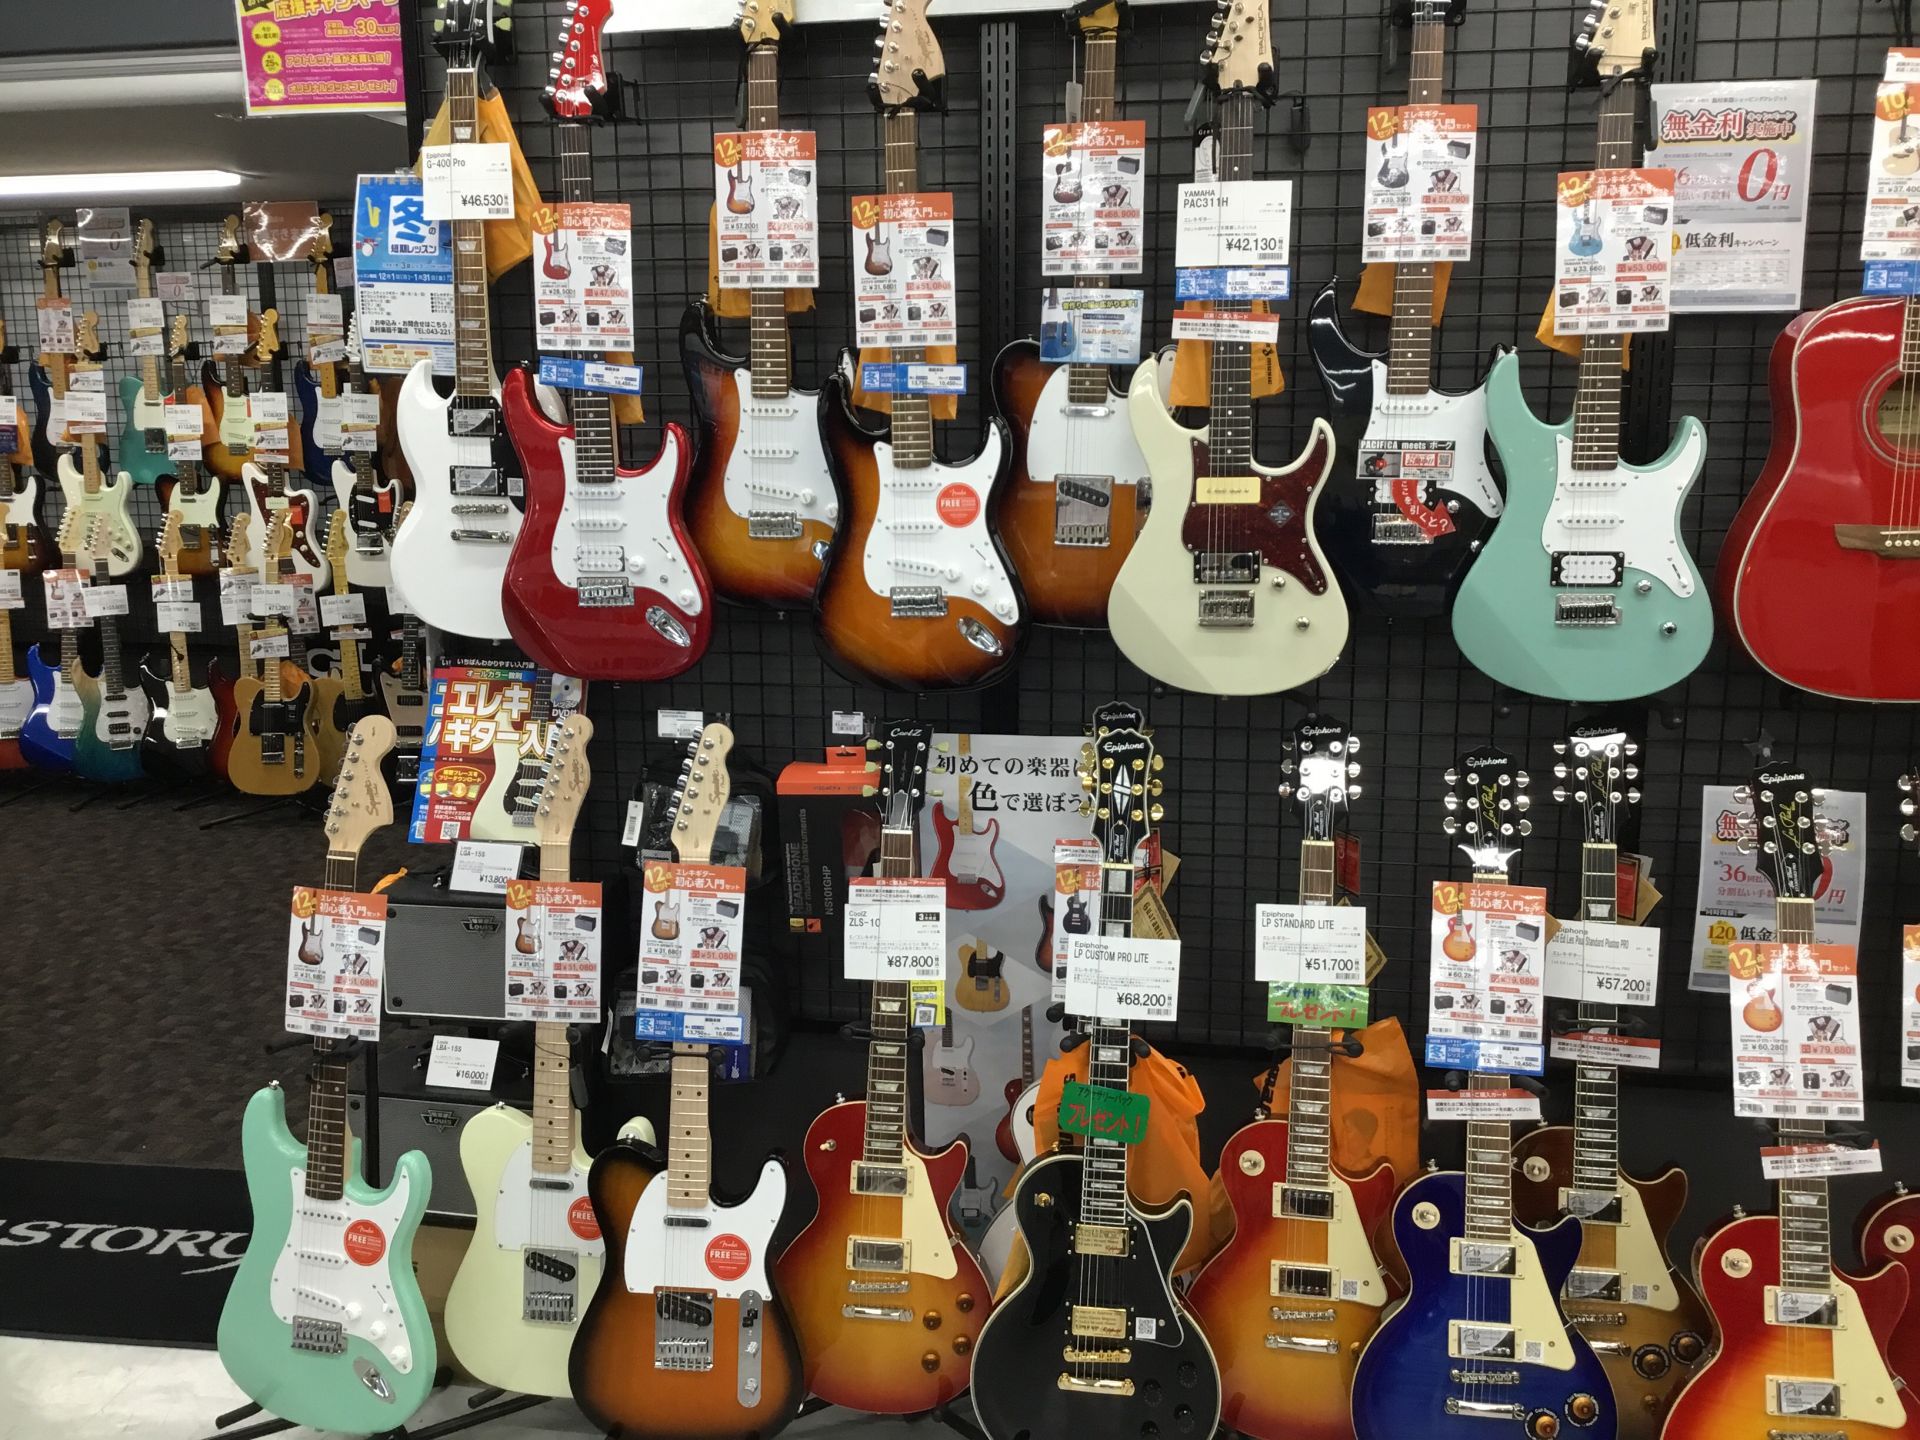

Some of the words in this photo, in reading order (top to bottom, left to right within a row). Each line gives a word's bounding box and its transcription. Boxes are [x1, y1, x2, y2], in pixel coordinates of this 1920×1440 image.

[1404, 110, 1446, 119] エレキギター
[1664, 110, 1744, 139] 無金利
[1747, 121, 1793, 137] 実施中
[426, 158, 451, 169] G-400
[452, 158, 465, 168] Pro
[1184, 189, 1215, 197] YAMAHA
[461, 194, 503, 207] ¥46,530
[1183, 197, 1229, 208] PAC311H
[391, 243, 437, 254] 短期レッスン
[1226, 237, 1277, 251] ¥42,130
[1360, 440, 1398, 449] PACIFICA
[1401, 440, 1426, 449] meets
[1429, 441, 1452, 449] ホーク
[940, 499, 960, 508] FREE
[448, 681, 531, 720] エレキ
[552, 700, 577, 708] レッスン
[1100, 711, 1136, 721] Epiphone
[891, 728, 923, 738] CoolZ
[1302, 725, 1341, 737] Epiphone
[1575, 727, 1617, 738] Epiphone
[1103, 742, 1144, 753] Epiphone
[937, 755, 1080, 777] 初めての楽器
[1465, 757, 1508, 768] Epiphone
[1759, 773, 1804, 784] Epiphone
[480, 874, 508, 884] ¥13,800
[676, 876, 740, 890] 初心者入門セット
[1470, 889, 1514, 897] エレキギター
[320, 895, 358, 903] エレキギター
[1262, 910, 1295, 918] Epiphone
[848, 918, 881, 927] ZLS-10
[1262, 918, 1271, 928] LP
[1274, 919, 1316, 929] STANDARD
[1318, 920, 1334, 930] LITE
[1074, 941, 1109, 951] Epiphone
[1621, 940, 1629, 949] PRO
[887, 955, 934, 968] ¥87,800
[1073, 949, 1083, 959] LP
[1085, 950, 1115, 961] CUSTOM
[1117, 951, 1132, 962] PRO
[1134, 953, 1149, 963] LITE
[1305, 958, 1354, 971] ¥51,700
[1597, 976, 1645, 992] ¥57,200
[1116, 992, 1166, 1006] ¥68,200
[456, 1070, 485, 1080] ¥16,000
[572, 1211, 592, 1220] FREE
[348, 1233, 367, 1244] FREE
[710, 1249, 730, 1259] FREE
